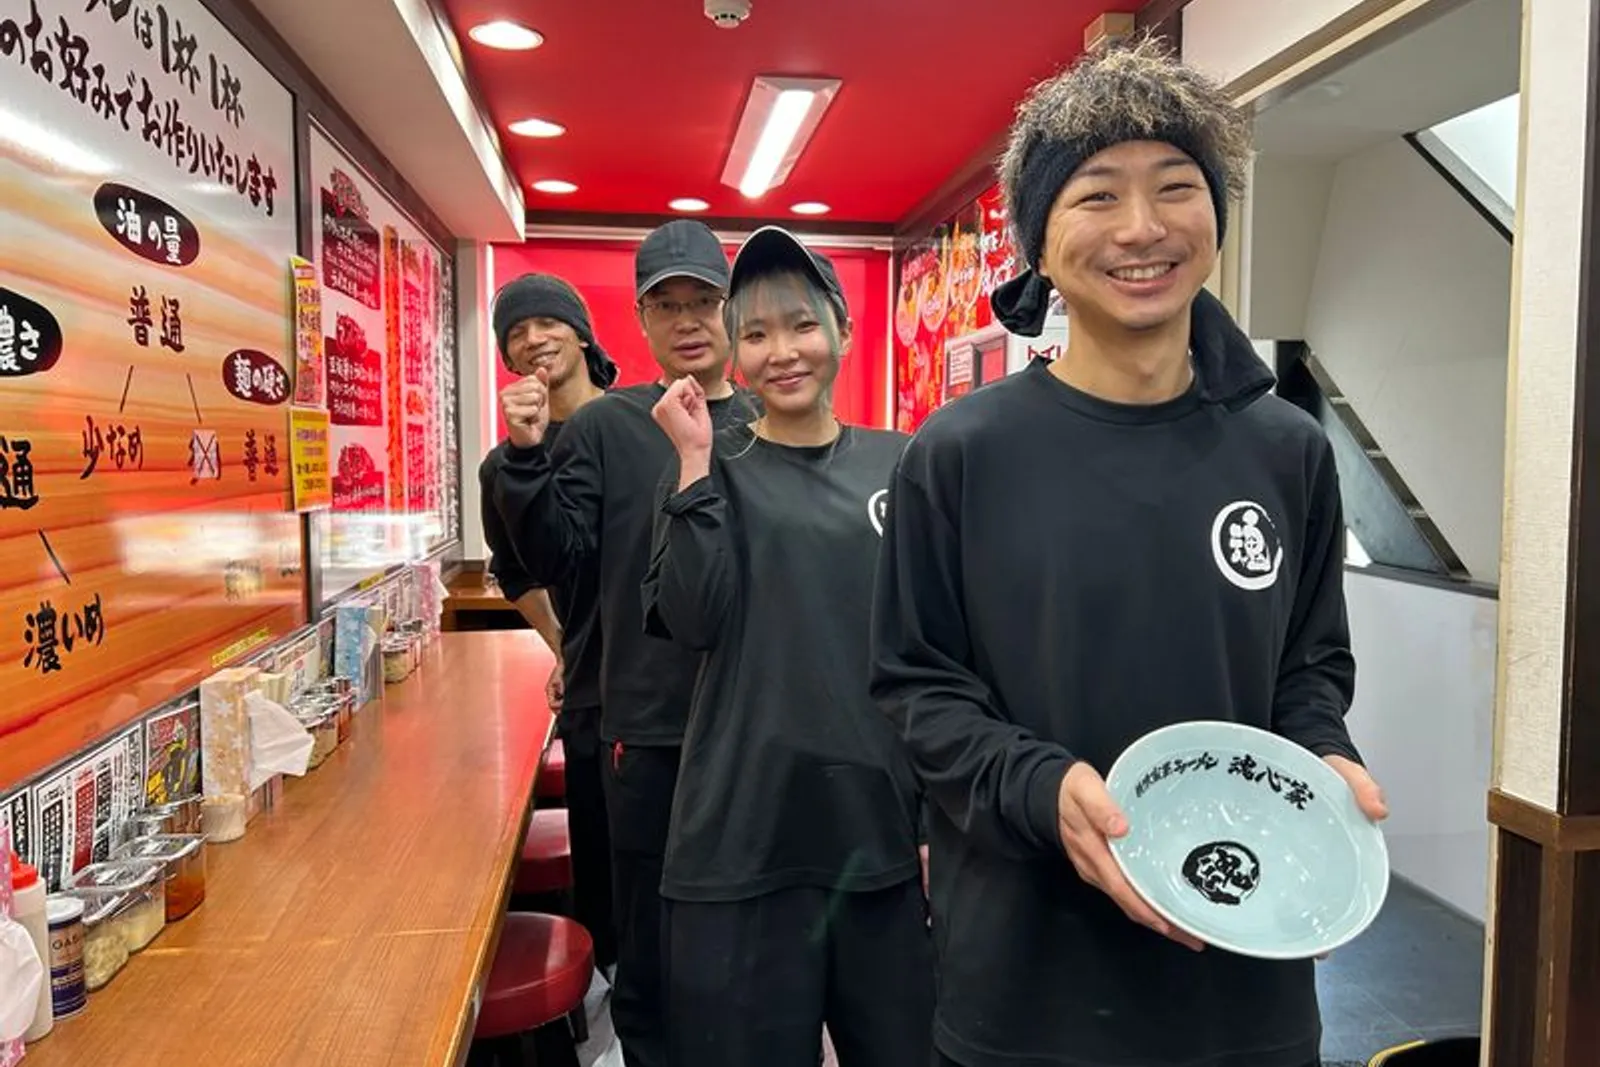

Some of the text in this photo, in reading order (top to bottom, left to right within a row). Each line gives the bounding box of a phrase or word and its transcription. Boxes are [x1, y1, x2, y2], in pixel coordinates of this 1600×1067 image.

[0, 0, 277, 216] のお好みでお作りいたします
[116, 198, 181, 264] 油の量
[128, 285, 185, 352] 普通
[80, 415, 143, 480] 少なめ
[24, 593, 104, 673] 濃いめ
[1228, 754, 1314, 811] 魂心家
